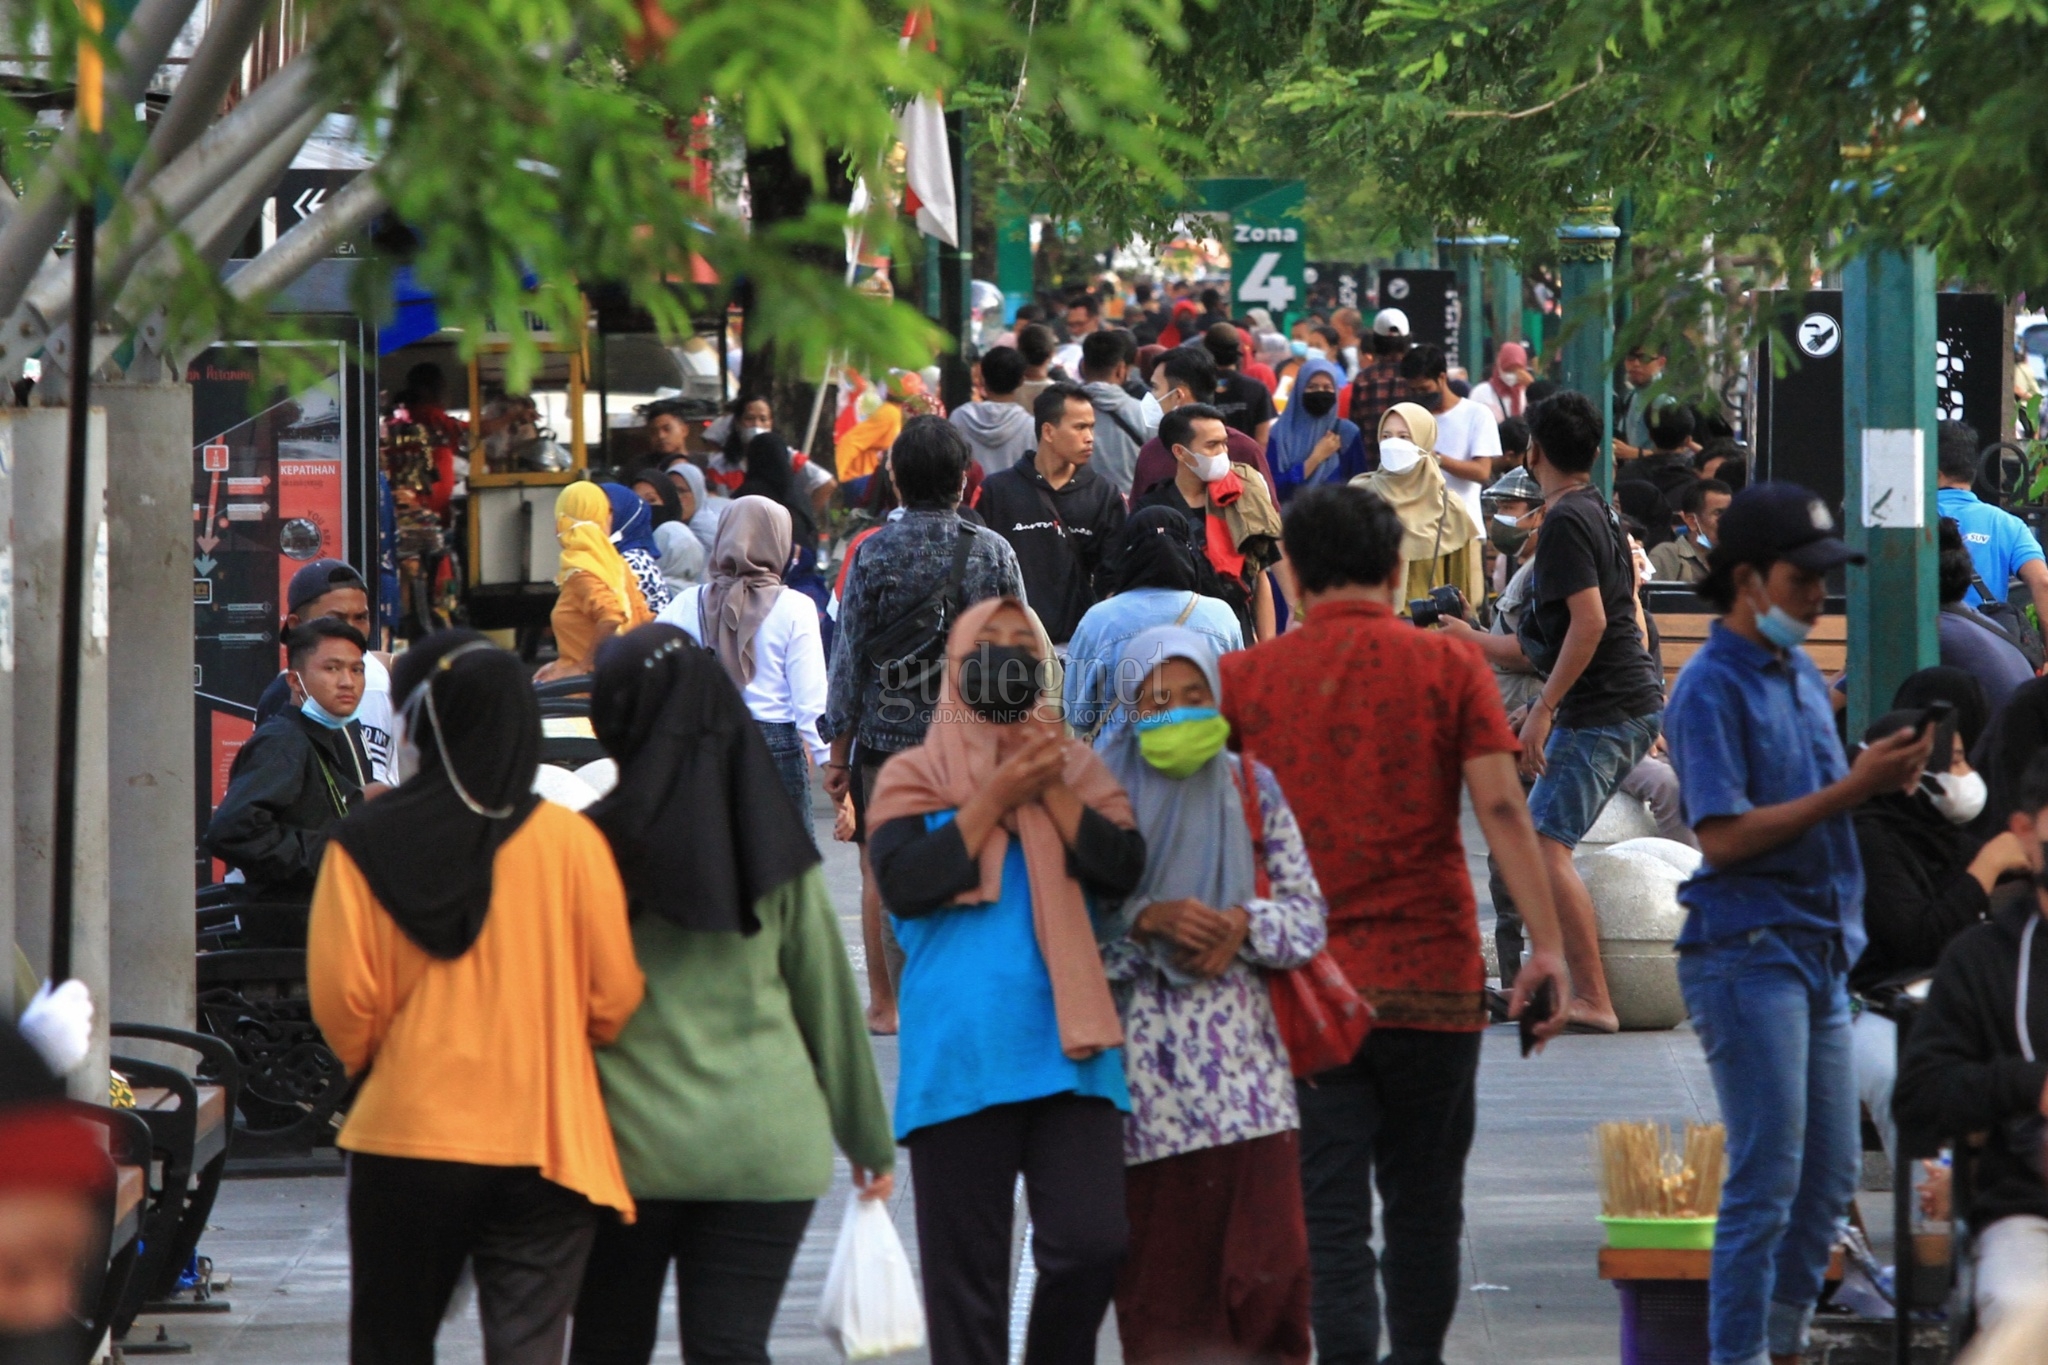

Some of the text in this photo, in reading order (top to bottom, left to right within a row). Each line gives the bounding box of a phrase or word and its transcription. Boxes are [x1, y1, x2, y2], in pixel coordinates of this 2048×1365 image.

[1234, 224, 1298, 243] Zona
[1238, 252, 1297, 312] 4
[280, 465, 336, 476] KEPATIHAN
[307, 509, 325, 526] YOU
[322, 529, 331, 546] ARE
